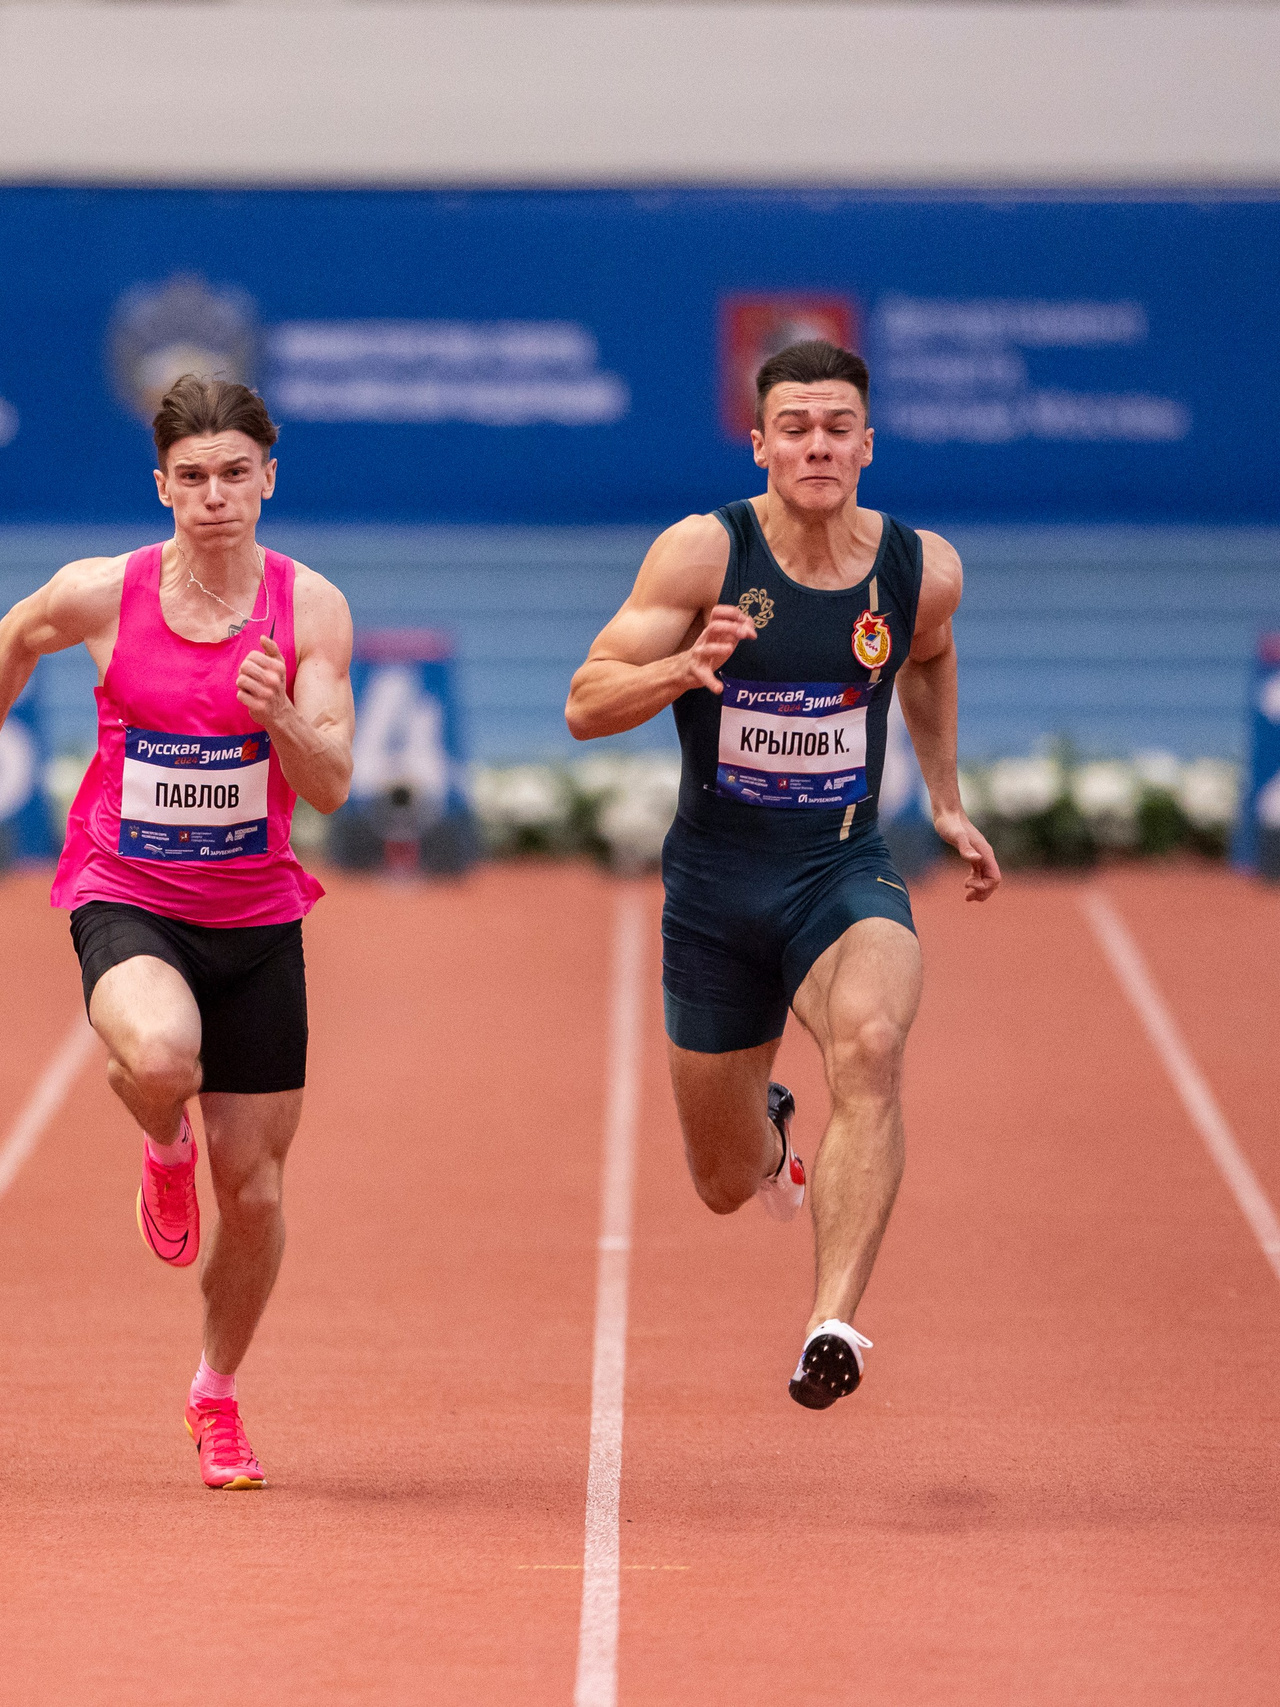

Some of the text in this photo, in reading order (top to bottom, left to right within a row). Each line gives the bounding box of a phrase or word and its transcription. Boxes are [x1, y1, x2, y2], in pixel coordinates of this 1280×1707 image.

[736, 690, 806, 706] Русская
[777, 704, 802, 712] 2024
[137, 740, 201, 758] Русская
[352, 664, 447, 820] 4
[740, 726, 850, 757] КРЫЛОВ К.
[174, 756, 198, 765] 2024
[155, 782, 240, 809] ПАВЛОВ
